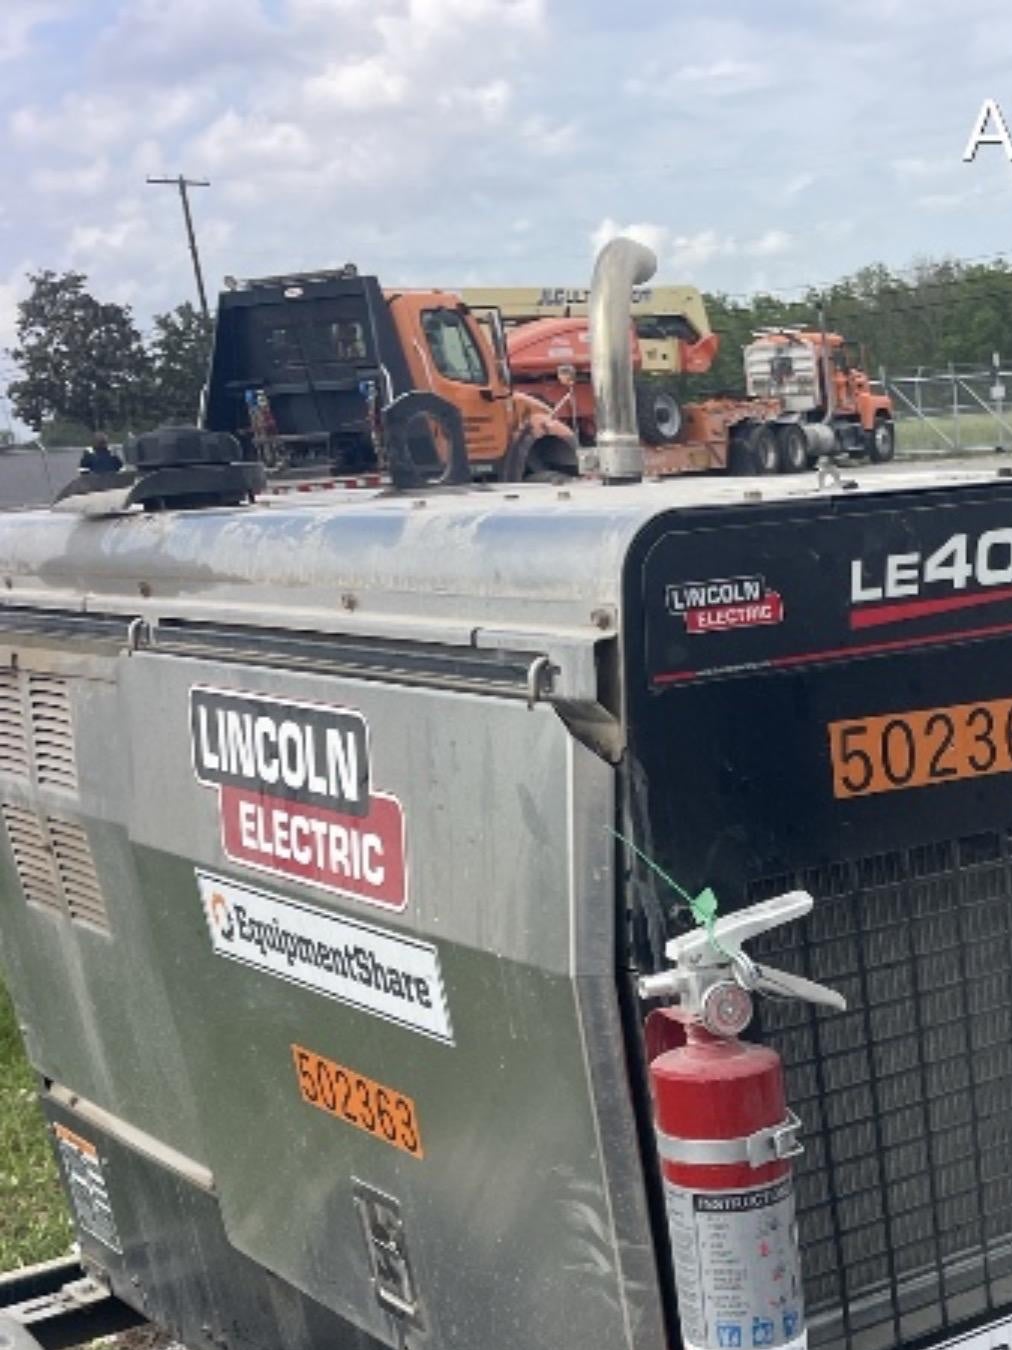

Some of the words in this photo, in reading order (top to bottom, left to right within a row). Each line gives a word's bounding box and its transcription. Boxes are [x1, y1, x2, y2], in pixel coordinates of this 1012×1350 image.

[671, 581, 760, 610] LINCOLN
[698, 605, 772, 628] ELECTRIC
[197, 704, 359, 802] LINCOLN
[238, 800, 385, 886] ELECTRIC
[233, 905, 433, 1009] EquipmentShare
[299, 1052, 418, 1153] 502363
